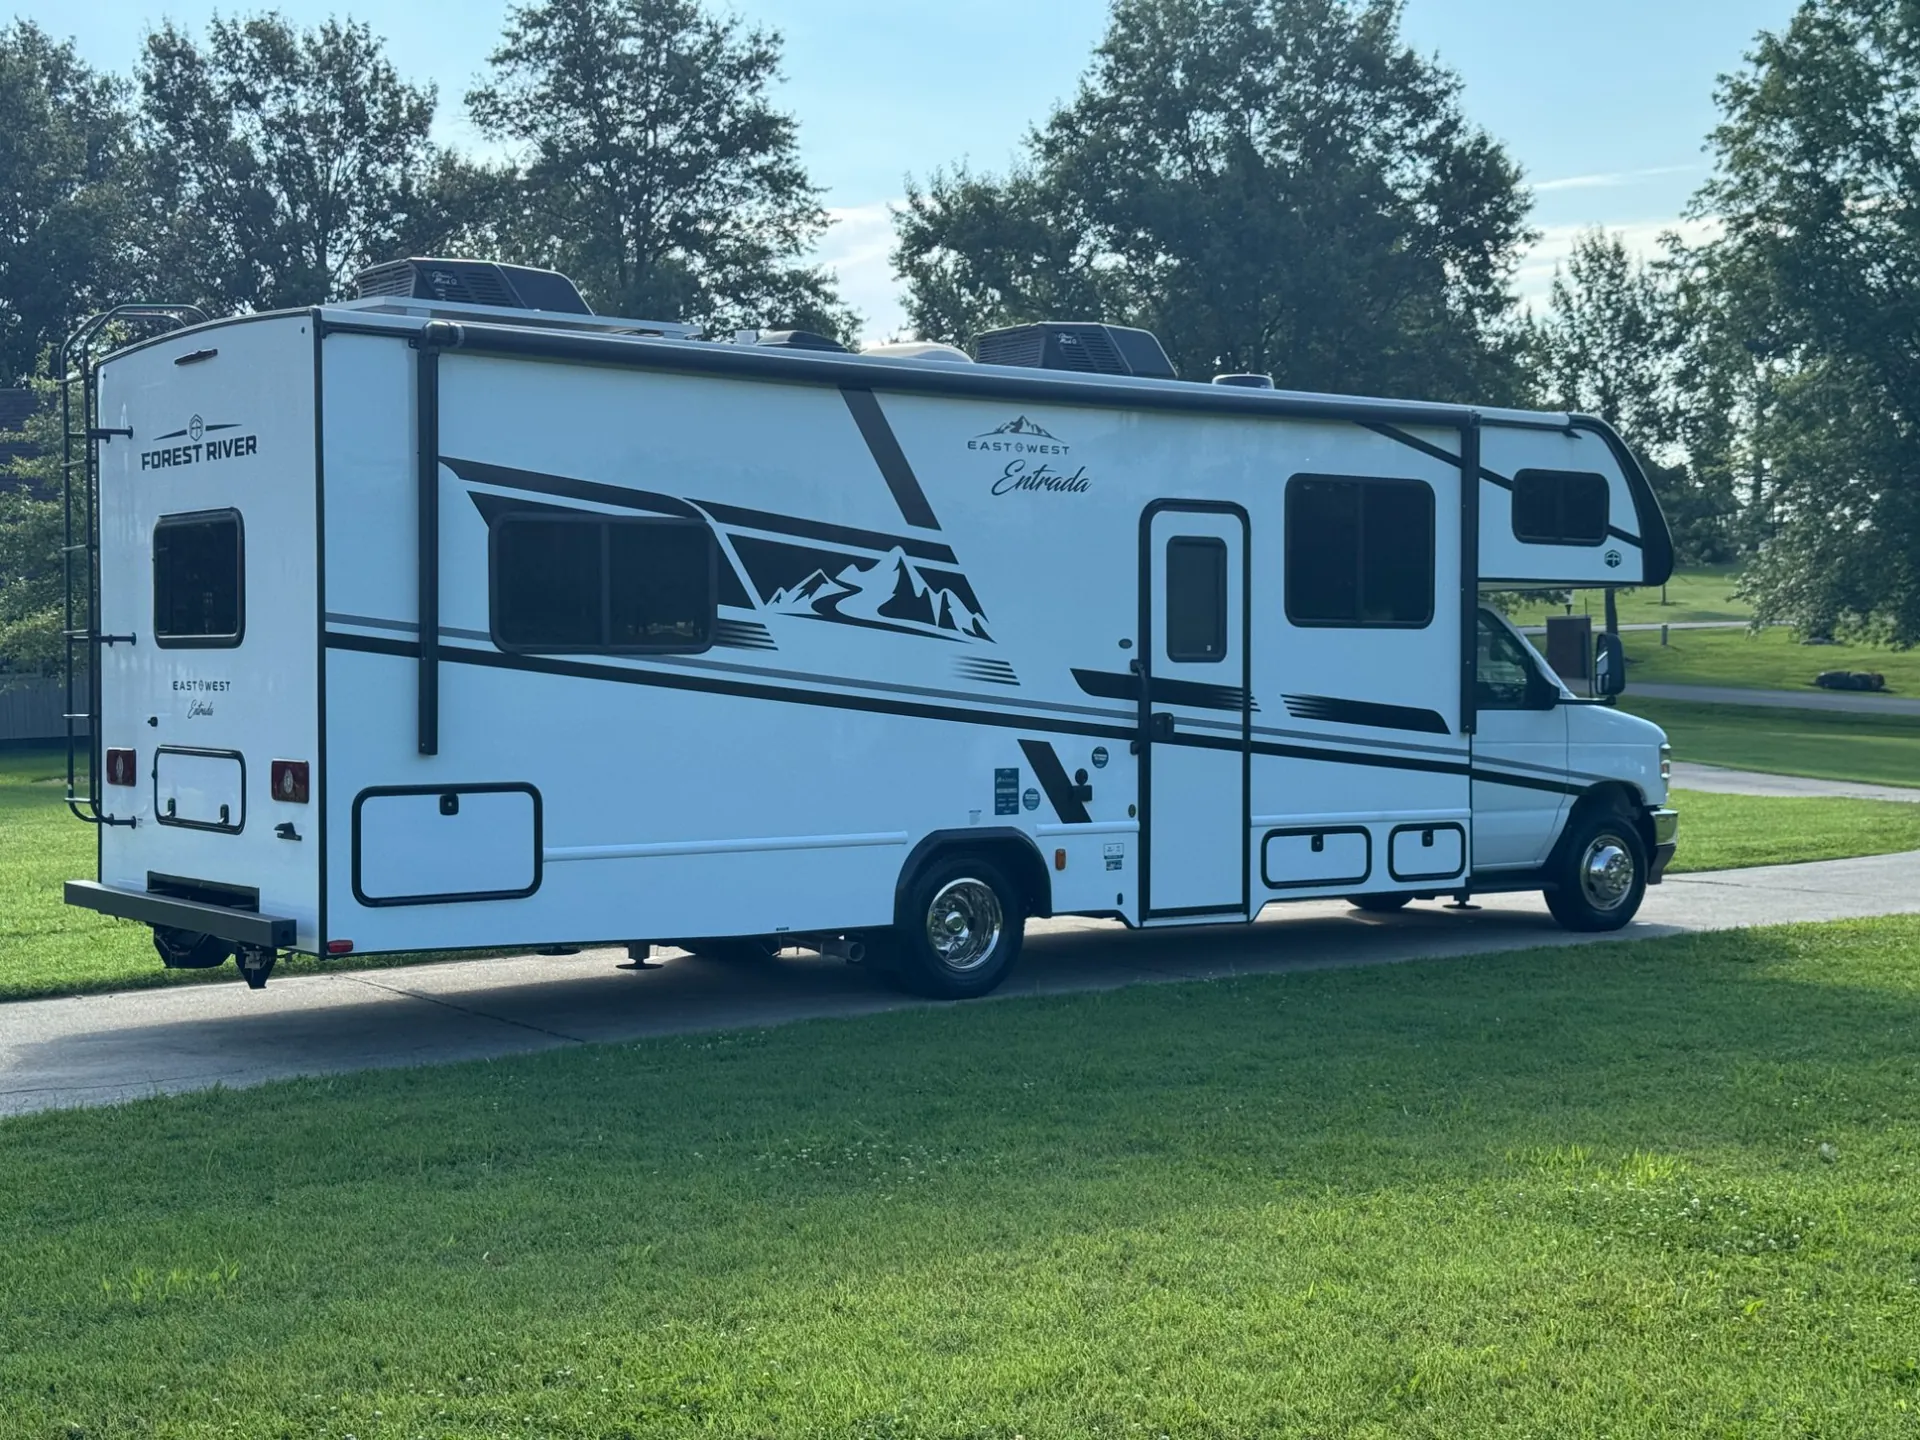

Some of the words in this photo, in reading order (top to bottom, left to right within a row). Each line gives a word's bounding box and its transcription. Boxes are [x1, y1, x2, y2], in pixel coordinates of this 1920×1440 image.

[141, 444, 203, 470] FOREST
[206, 435, 257, 461] RIVER
[967, 440, 1012, 452] EAST
[1026, 444, 1070, 455] WEST
[991, 459, 1092, 496] Entrada
[172, 680, 197, 691] EAST
[204, 681, 230, 691] WEST
